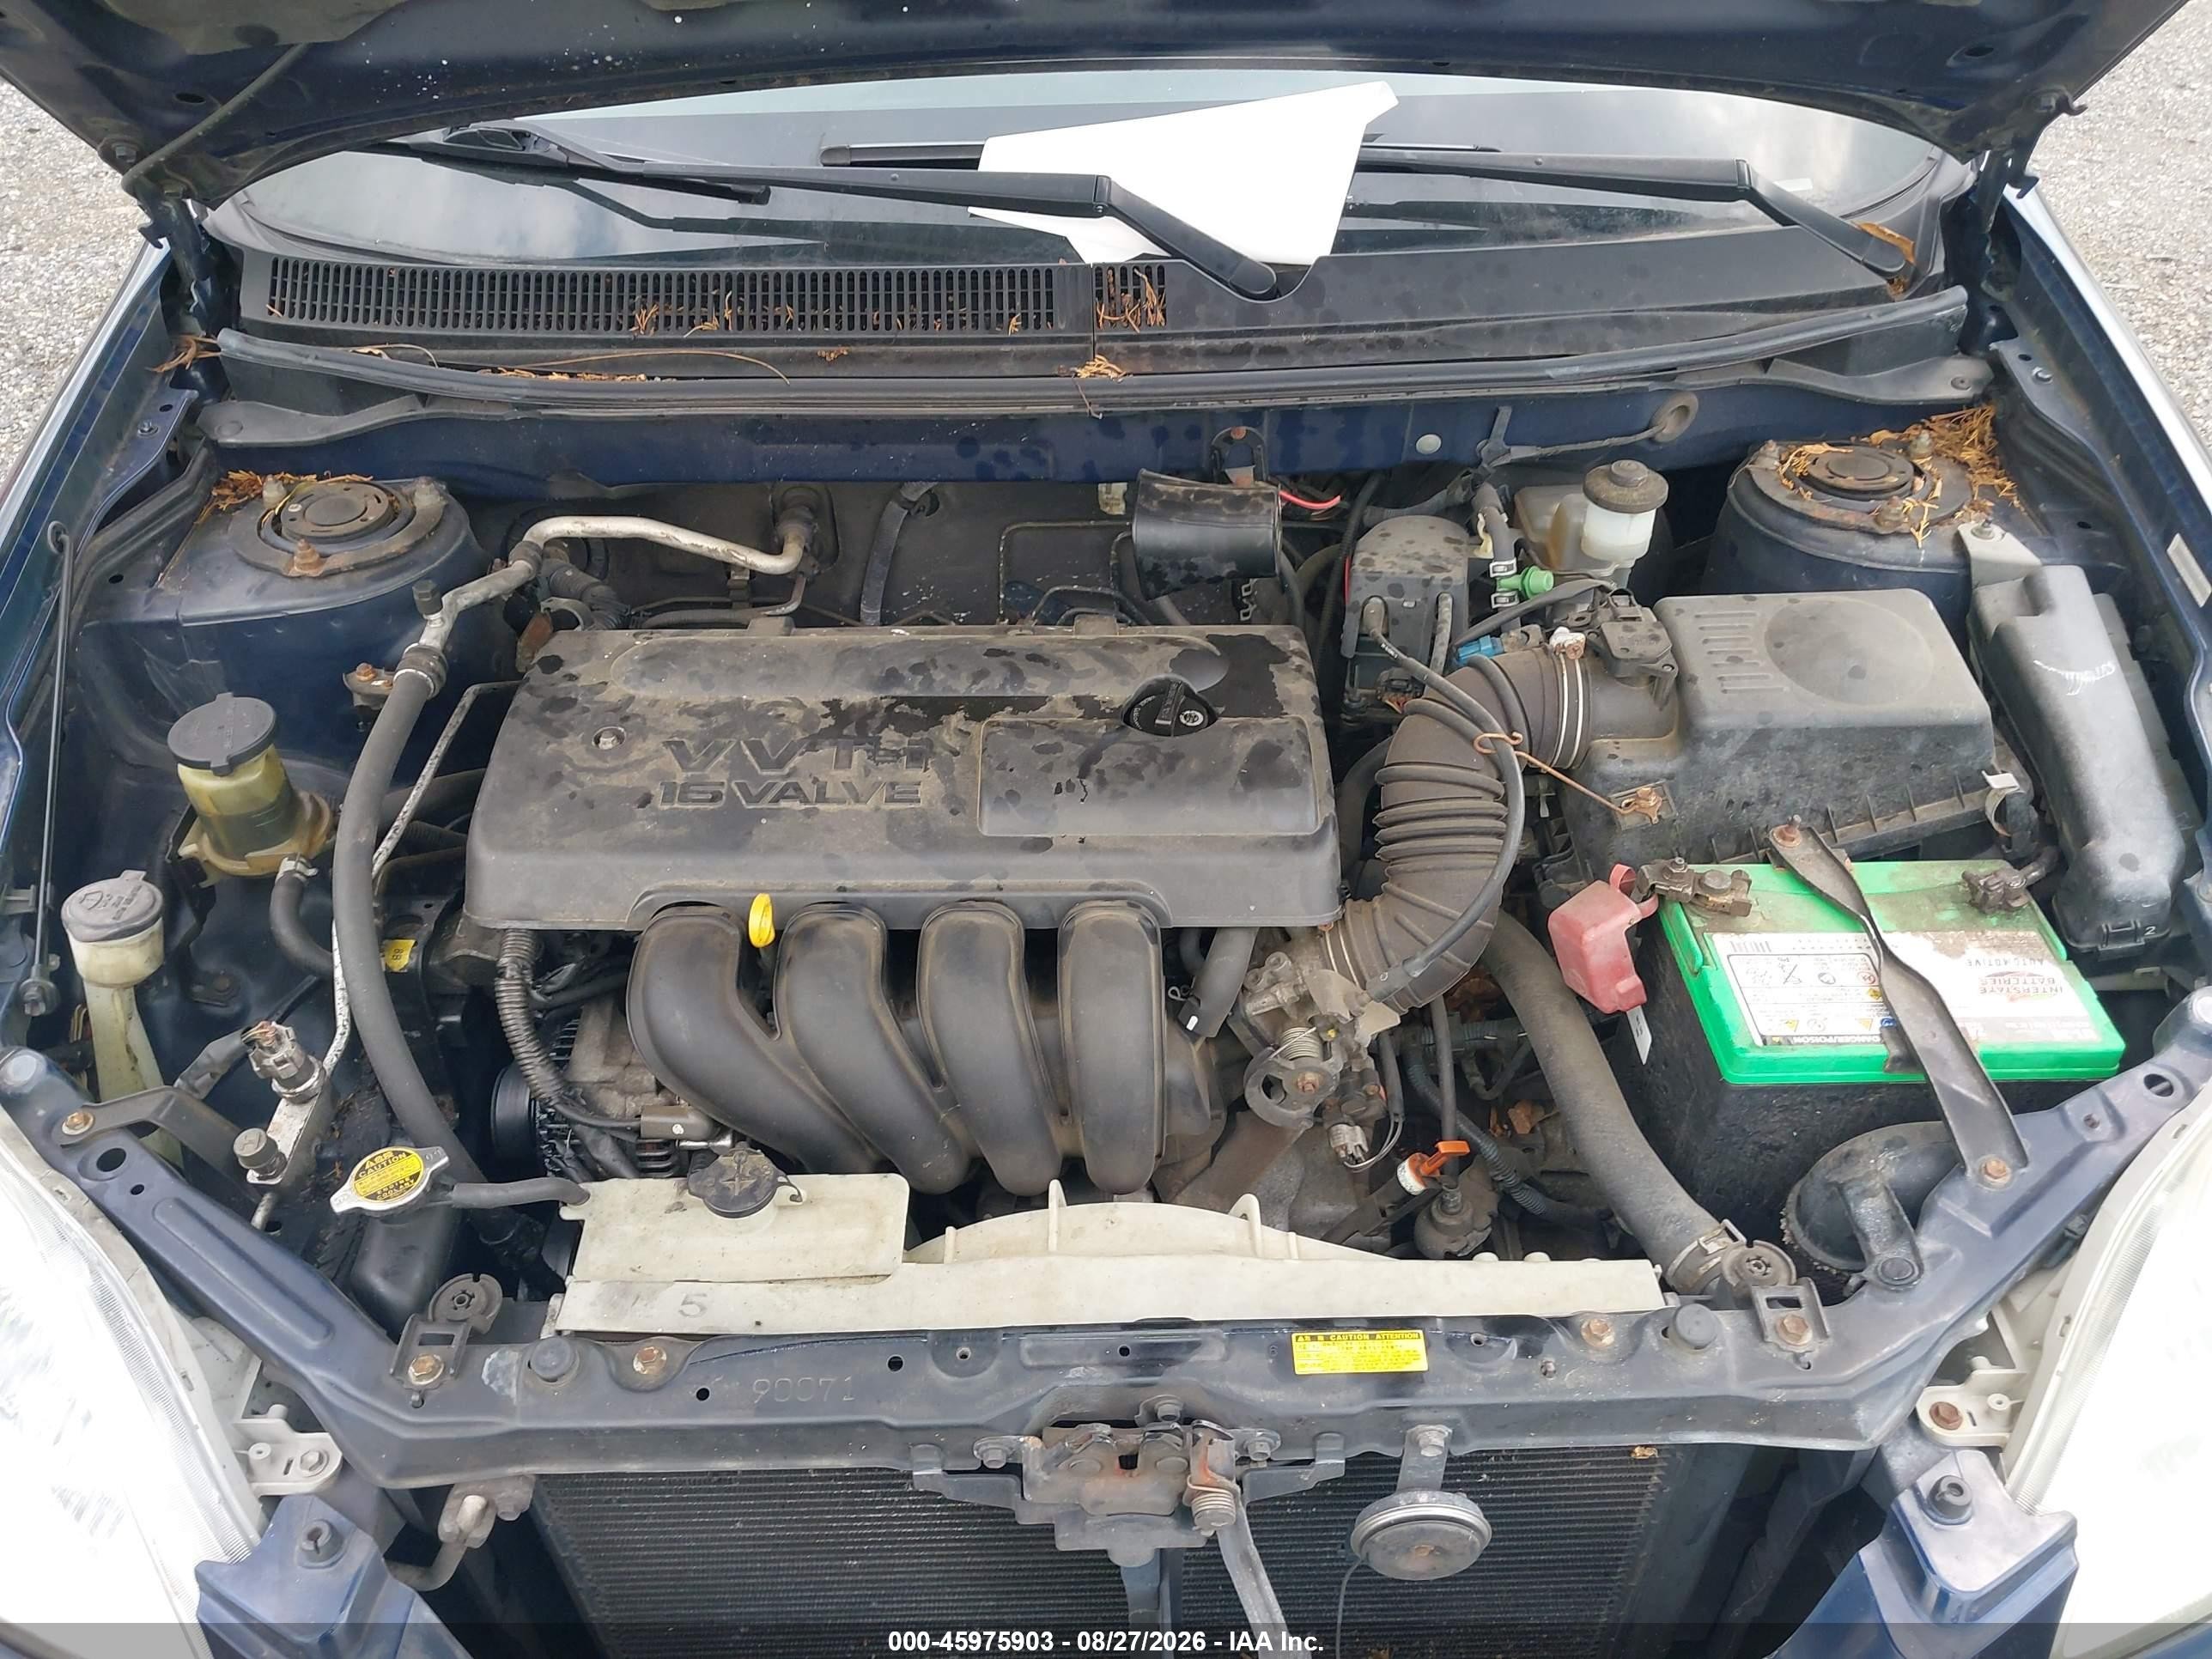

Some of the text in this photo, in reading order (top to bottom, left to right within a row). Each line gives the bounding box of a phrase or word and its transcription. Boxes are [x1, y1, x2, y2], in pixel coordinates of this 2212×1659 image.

[731, 780, 923, 809] VALVE
[2144, 926, 2156, 936] 2
[1980, 977, 2056, 986] BATTERIES
[358, 1152, 407, 1177] CAUTION
[678, 1292, 708, 1318] 5
